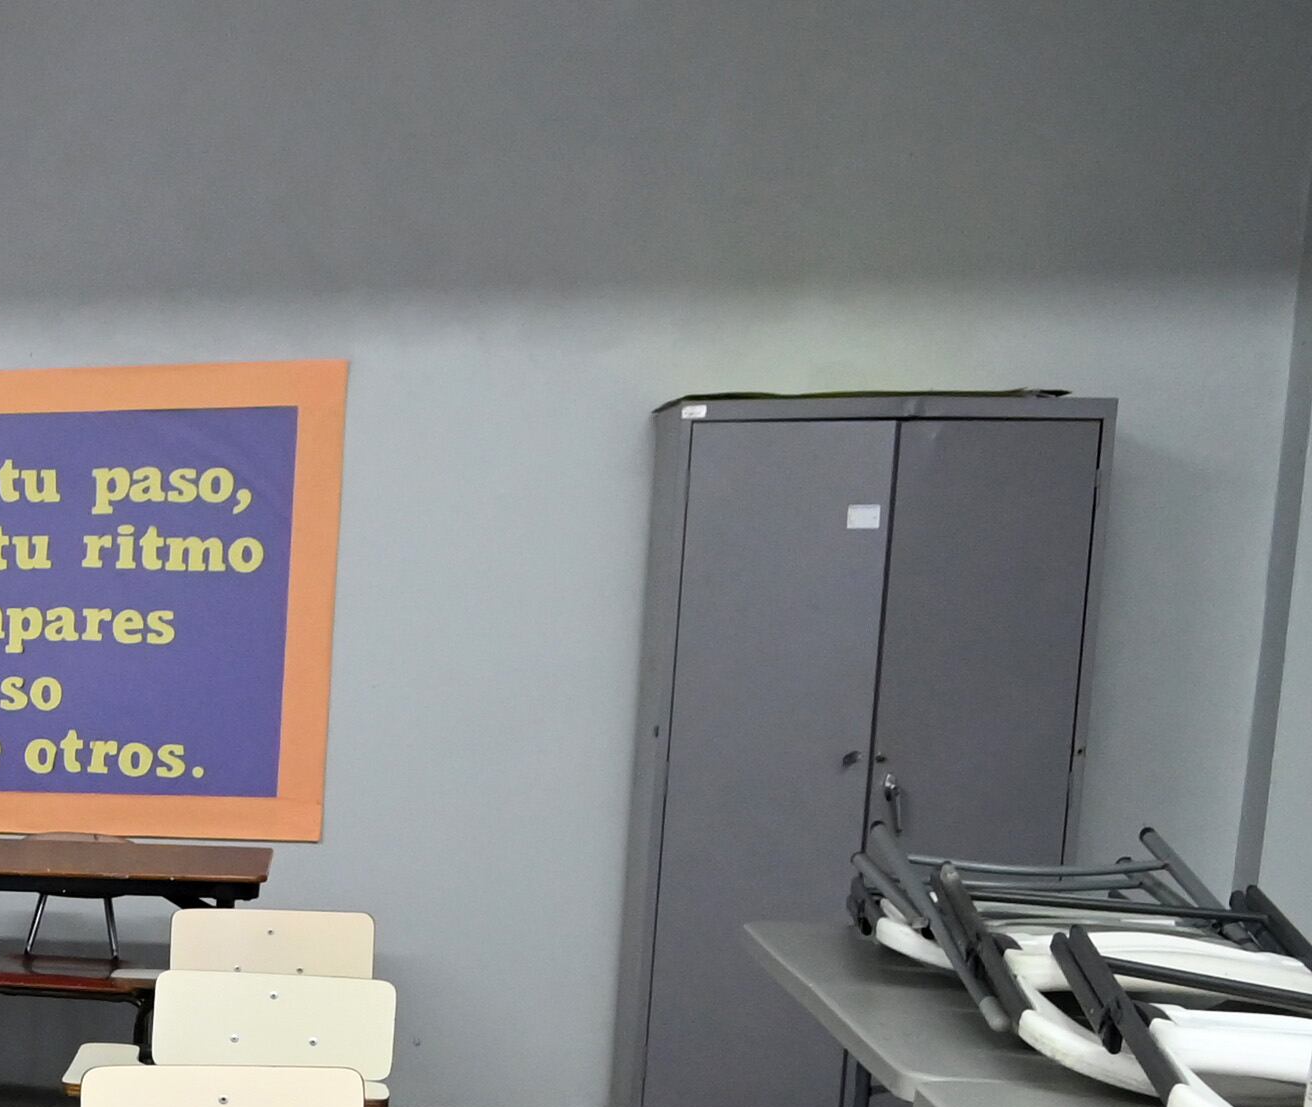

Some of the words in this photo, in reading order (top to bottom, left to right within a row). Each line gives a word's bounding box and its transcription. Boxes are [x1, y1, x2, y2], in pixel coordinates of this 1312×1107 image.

[92, 466, 254, 516] paso,
[82, 523, 266, 573] ritmo
[25, 729, 206, 779] otros.
